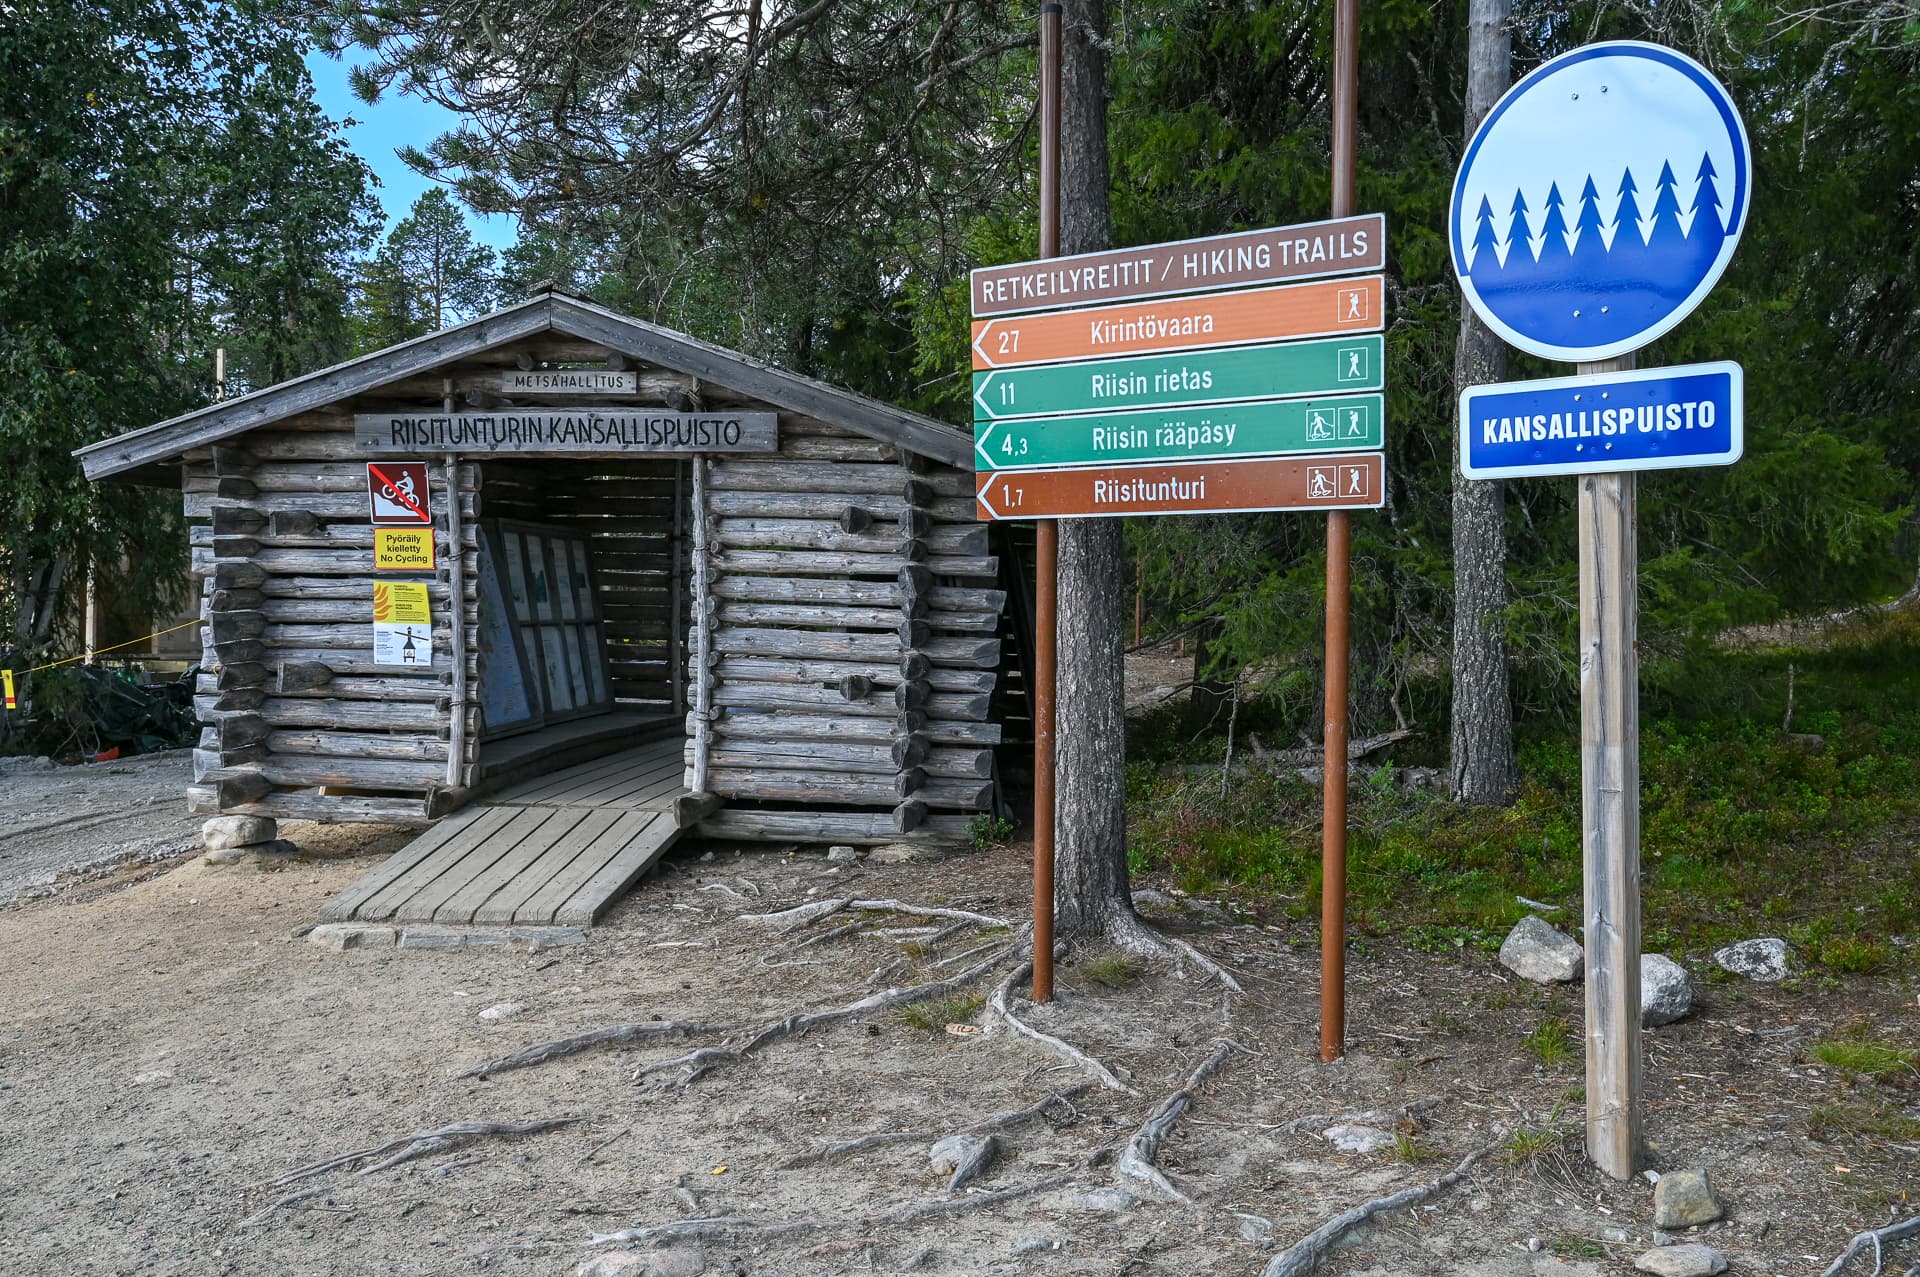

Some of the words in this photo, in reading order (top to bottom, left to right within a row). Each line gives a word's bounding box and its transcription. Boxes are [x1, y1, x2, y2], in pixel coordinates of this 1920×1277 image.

[982, 258, 1154, 303] RETKEILYREITIT
[1160, 256, 1175, 282] /
[1183, 244, 1271, 279] HIKING
[1278, 230, 1369, 266] TRAILS
[998, 329, 1020, 354] 27
[1090, 313, 1214, 345] Kirintövaara
[515, 374, 624, 388] METSÄHALLITUS
[999, 382, 1015, 405] 11
[1091, 371, 1148, 398] Riisin
[1154, 366, 1213, 391] rietas
[390, 417, 543, 446] RIISITUNTURIN
[550, 417, 741, 446] KANSALLISPUISTO
[1001, 433, 1028, 457] 4,3
[1092, 423, 1148, 451] Riisin
[1155, 420, 1237, 447] rääpäsy
[1483, 400, 1716, 444] KANSALLISPUISTO
[1003, 484, 1023, 509] 1,7
[1094, 475, 1206, 503] Riisitunturi
[386, 534, 422, 544] Pyöräily
[387, 545, 421, 554] kielletty
[380, 554, 393, 562] No
[395, 554, 428, 564] Cycling
